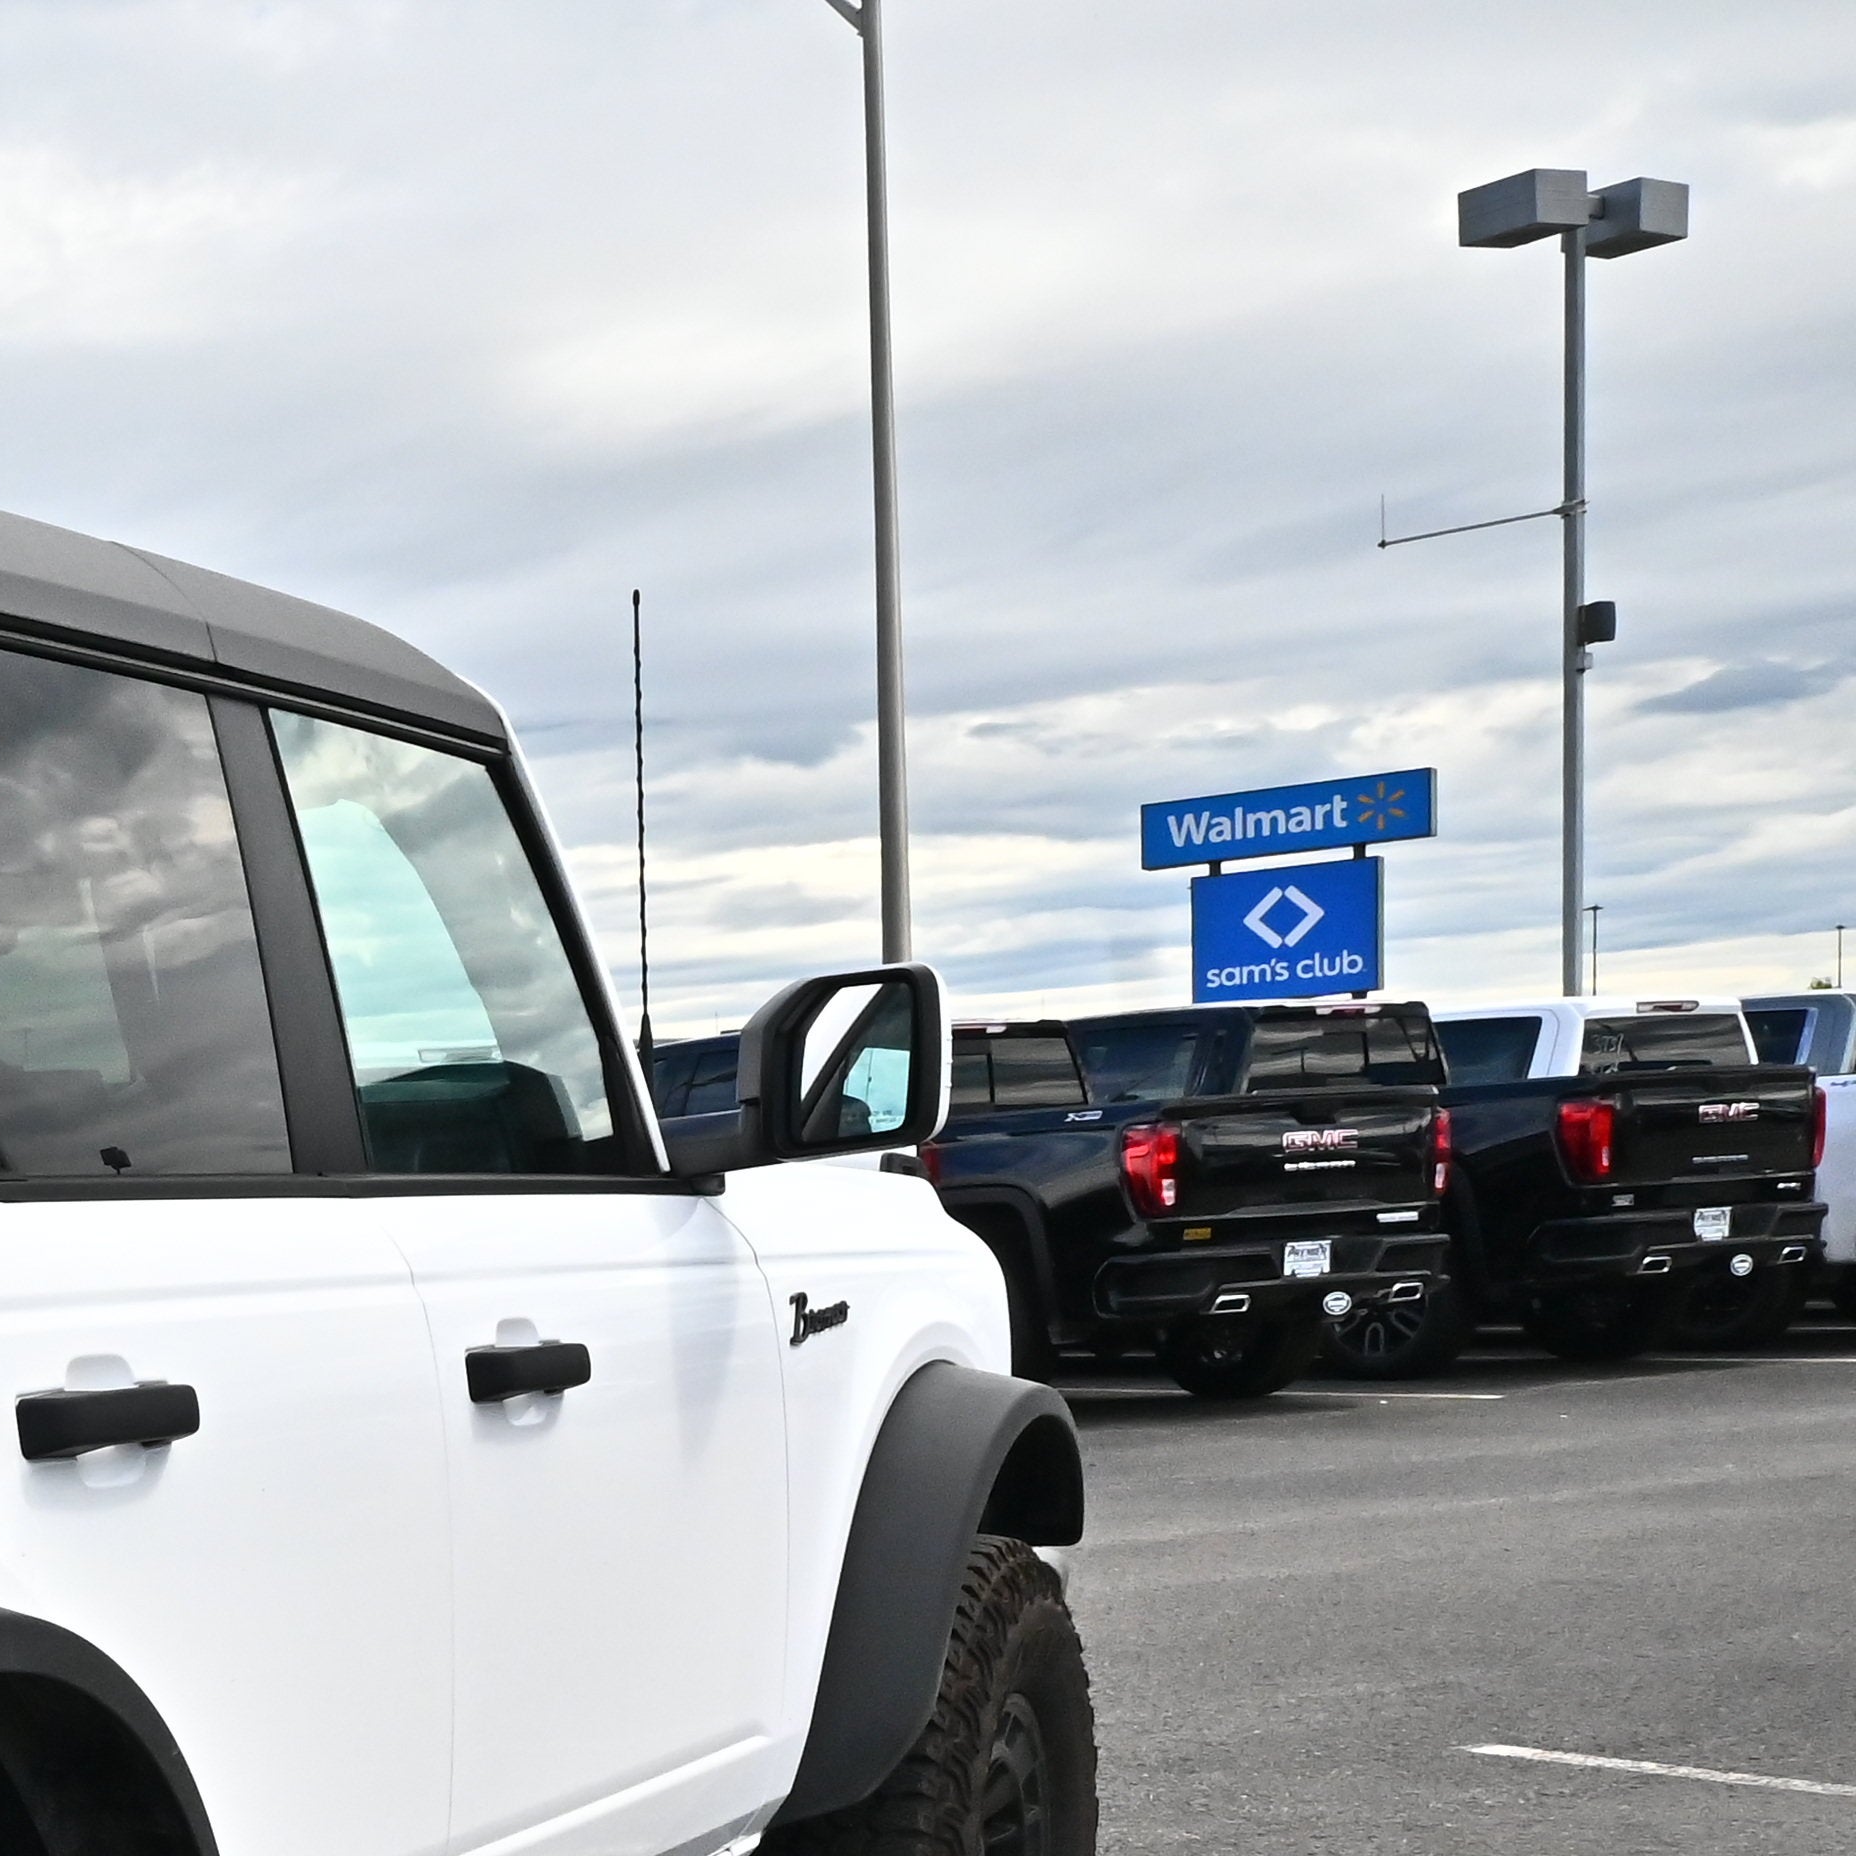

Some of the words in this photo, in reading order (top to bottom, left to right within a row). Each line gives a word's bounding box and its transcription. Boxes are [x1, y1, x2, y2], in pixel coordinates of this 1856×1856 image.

[1167, 794, 1348, 848] Walmart
[1206, 957, 1289, 988] sam's
[1296, 950, 1364, 979] club
[1282, 1129, 1359, 1152] GMC
